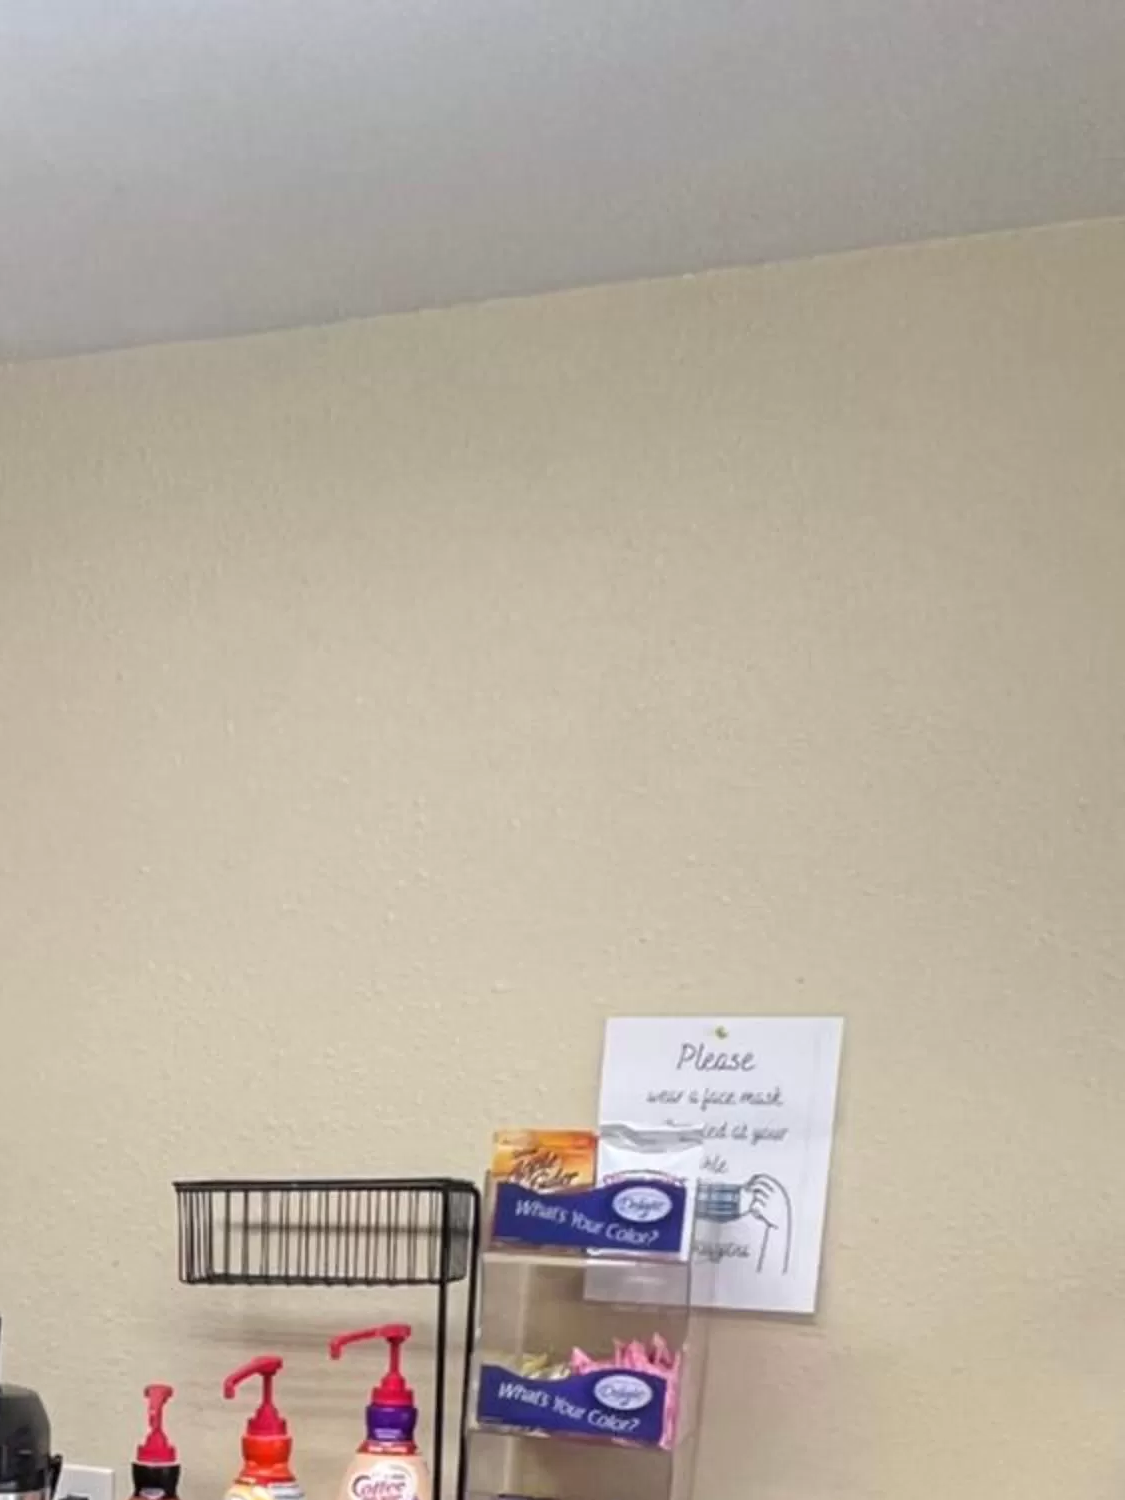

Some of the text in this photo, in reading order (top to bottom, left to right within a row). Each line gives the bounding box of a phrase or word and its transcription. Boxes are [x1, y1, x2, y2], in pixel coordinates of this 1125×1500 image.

[676, 1043, 756, 1071] Please
[646, 1085, 783, 1112] wear a face mask
[750, 1127, 789, 1145] your
[515, 1199, 660, 1247] What's Your Color?
[498, 1381, 641, 1433] What's Your Color?
